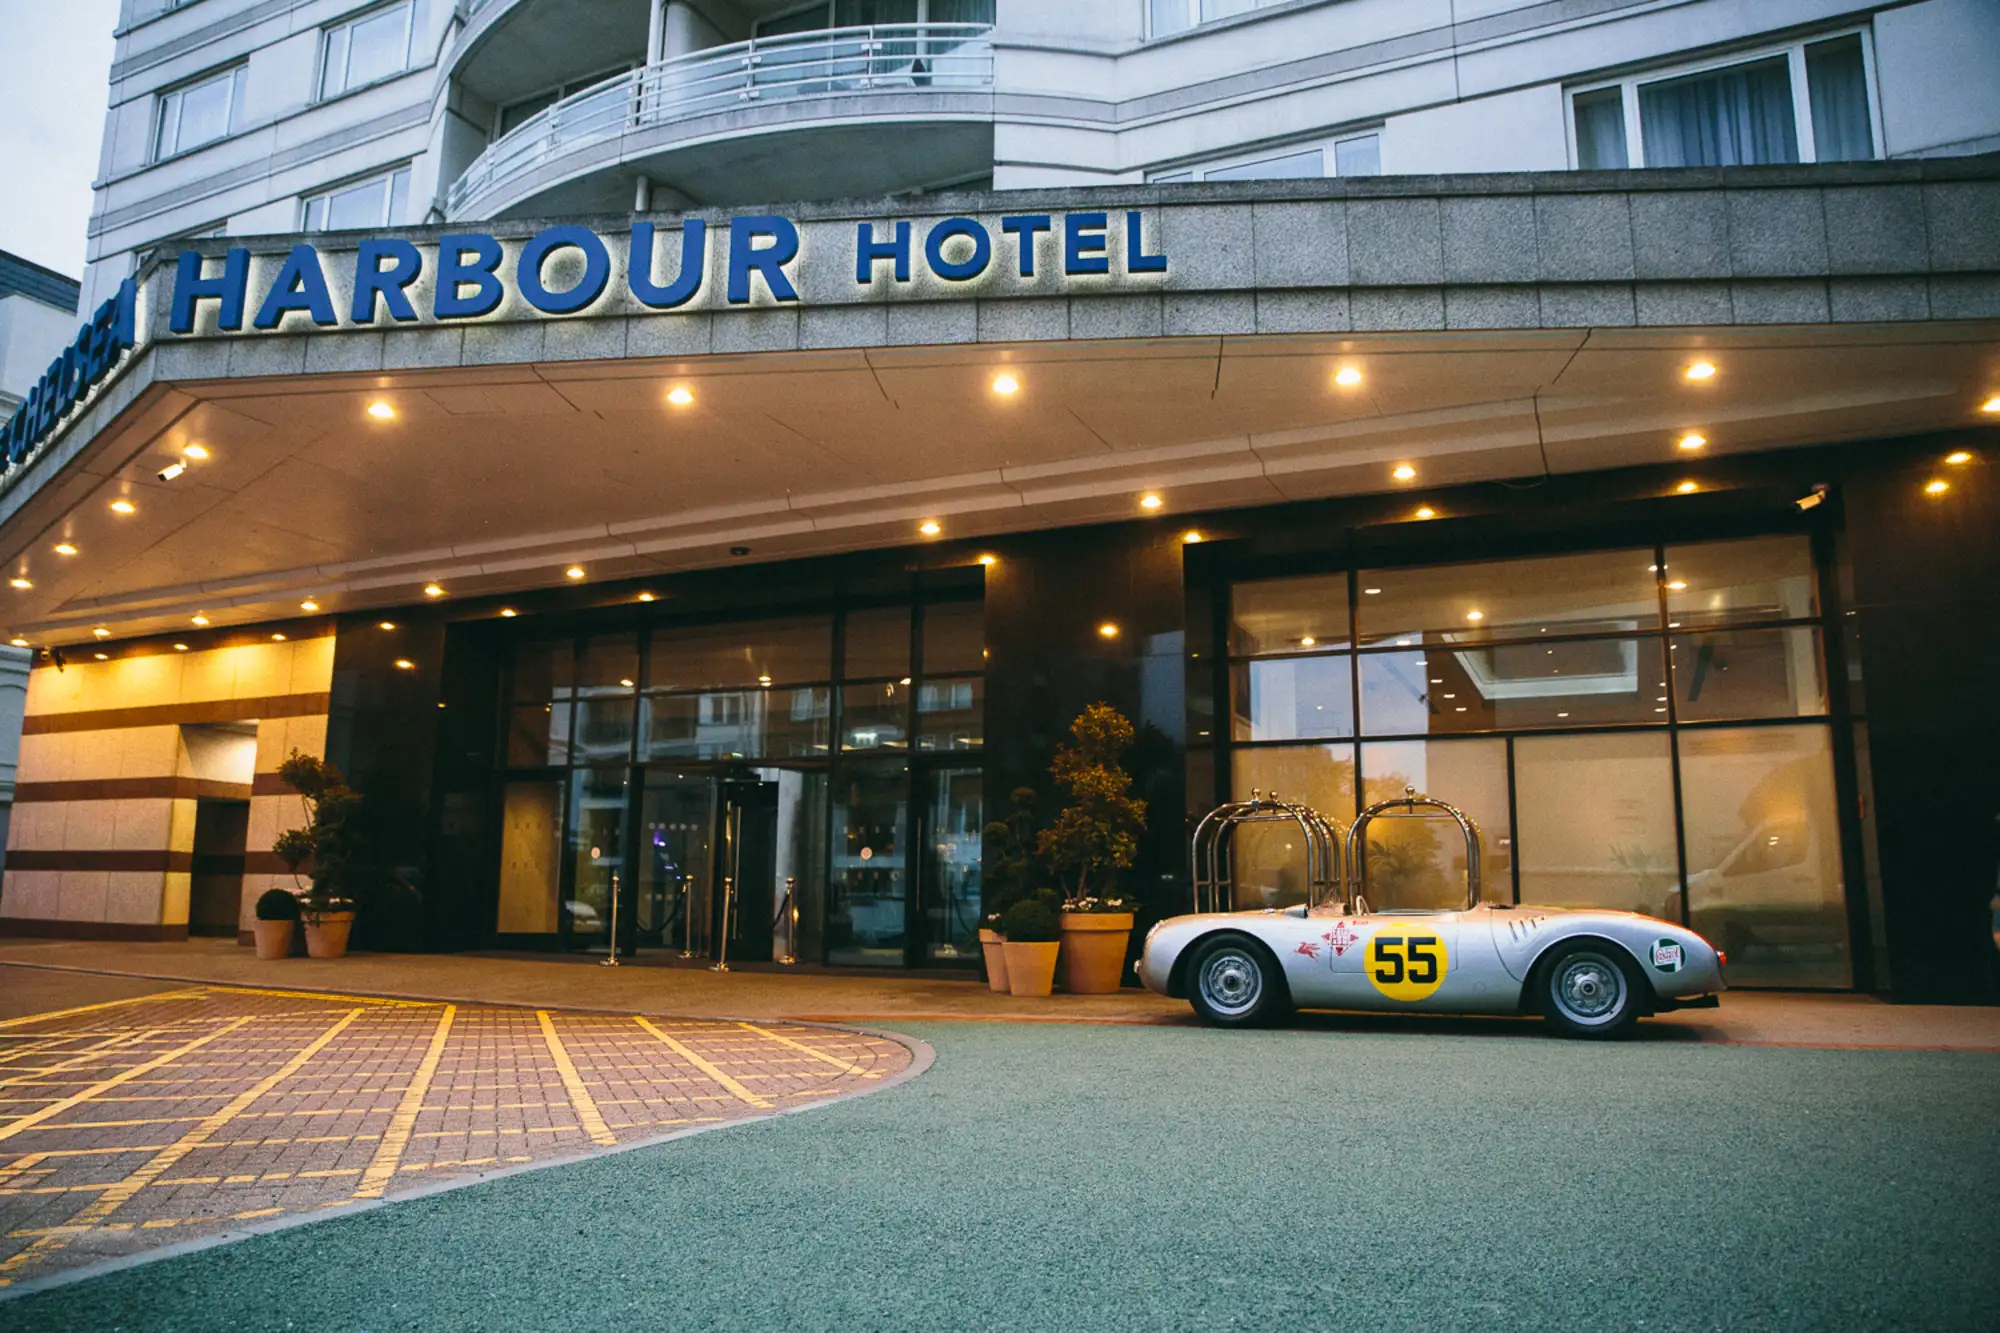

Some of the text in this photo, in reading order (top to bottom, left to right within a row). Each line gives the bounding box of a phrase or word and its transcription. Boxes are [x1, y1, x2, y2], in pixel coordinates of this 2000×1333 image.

[169, 211, 1167, 333] HARBOUR HOTEL
[9, 278, 136, 464] CHELSEA
[1375, 936, 1438, 983] 55
